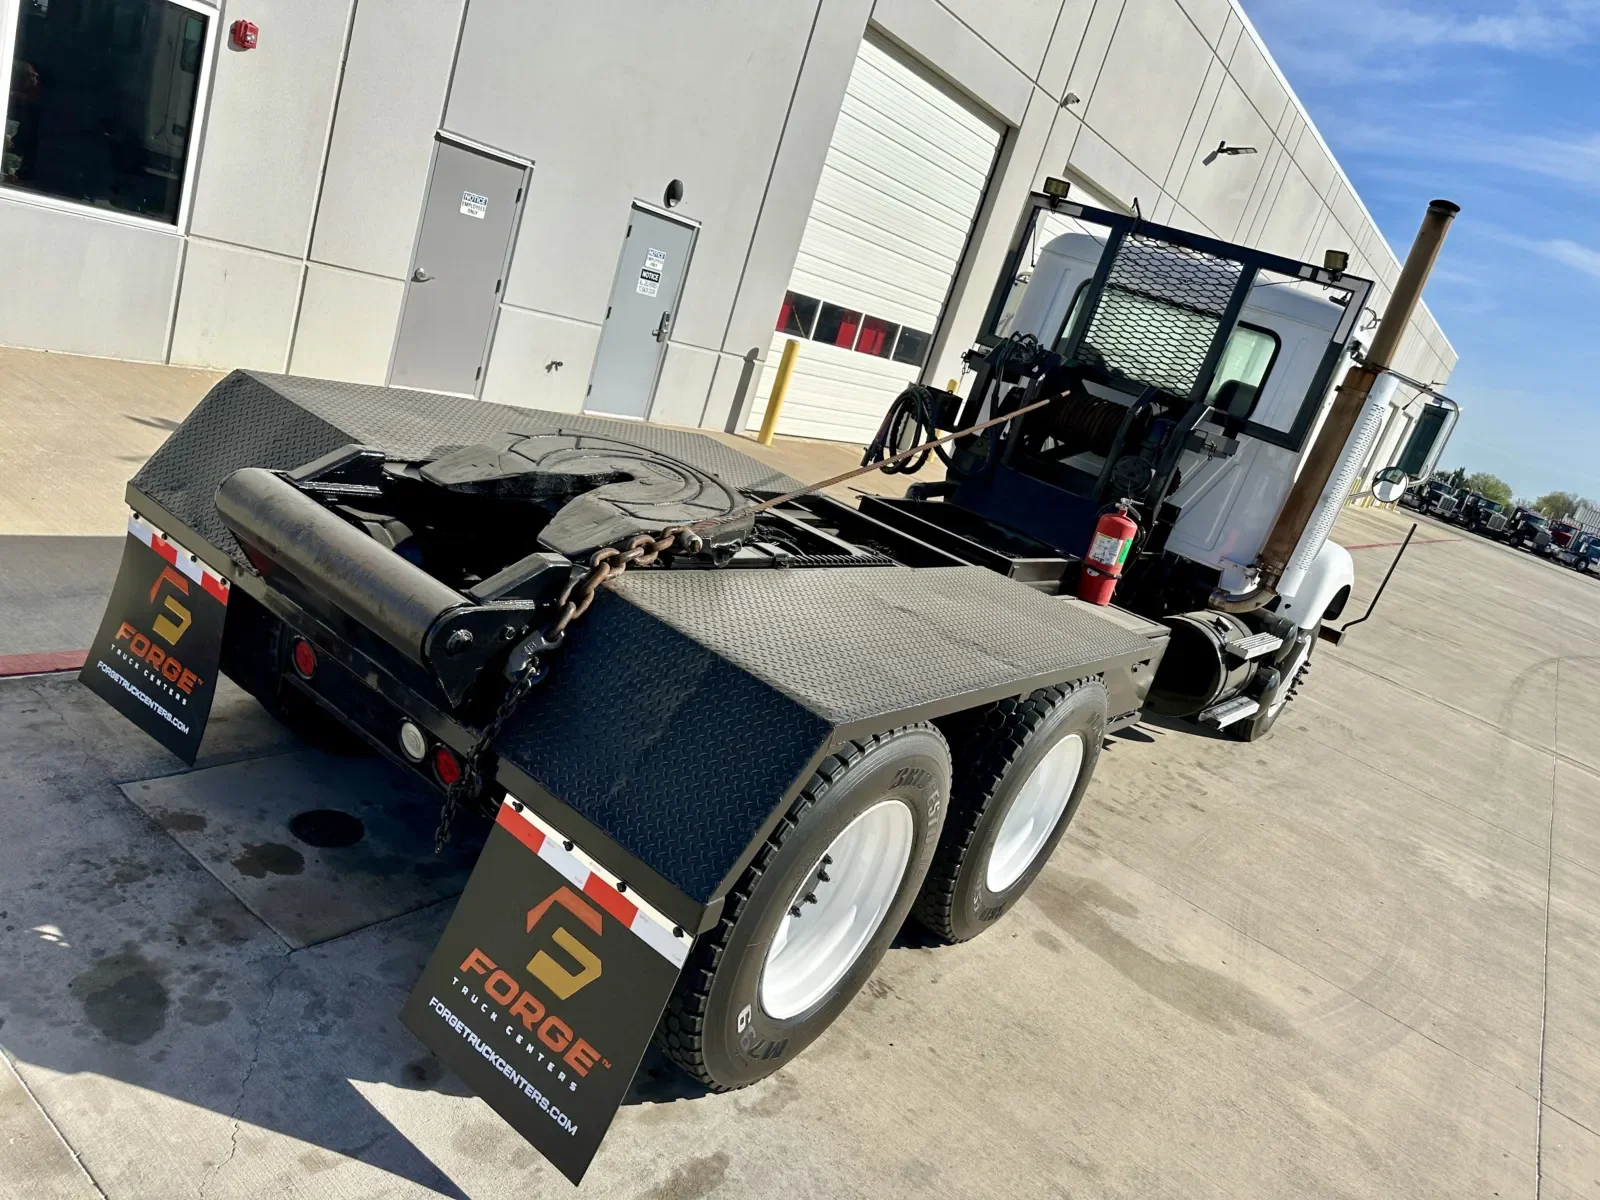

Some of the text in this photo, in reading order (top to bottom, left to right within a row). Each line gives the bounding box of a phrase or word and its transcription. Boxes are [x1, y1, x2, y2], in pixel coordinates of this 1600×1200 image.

[641, 270, 659, 281] NOTICE
[110, 643, 188, 706] TRUCK CENTERS
[114, 621, 198, 695] FORGE
[97, 660, 189, 735] FORGETRUCKCENTERS.COM
[452, 976, 577, 1092] TRUCK CENTERS
[459, 948, 601, 1077] FORGE
[429, 996, 578, 1137] FORGETRUCKCENTERS.COM
